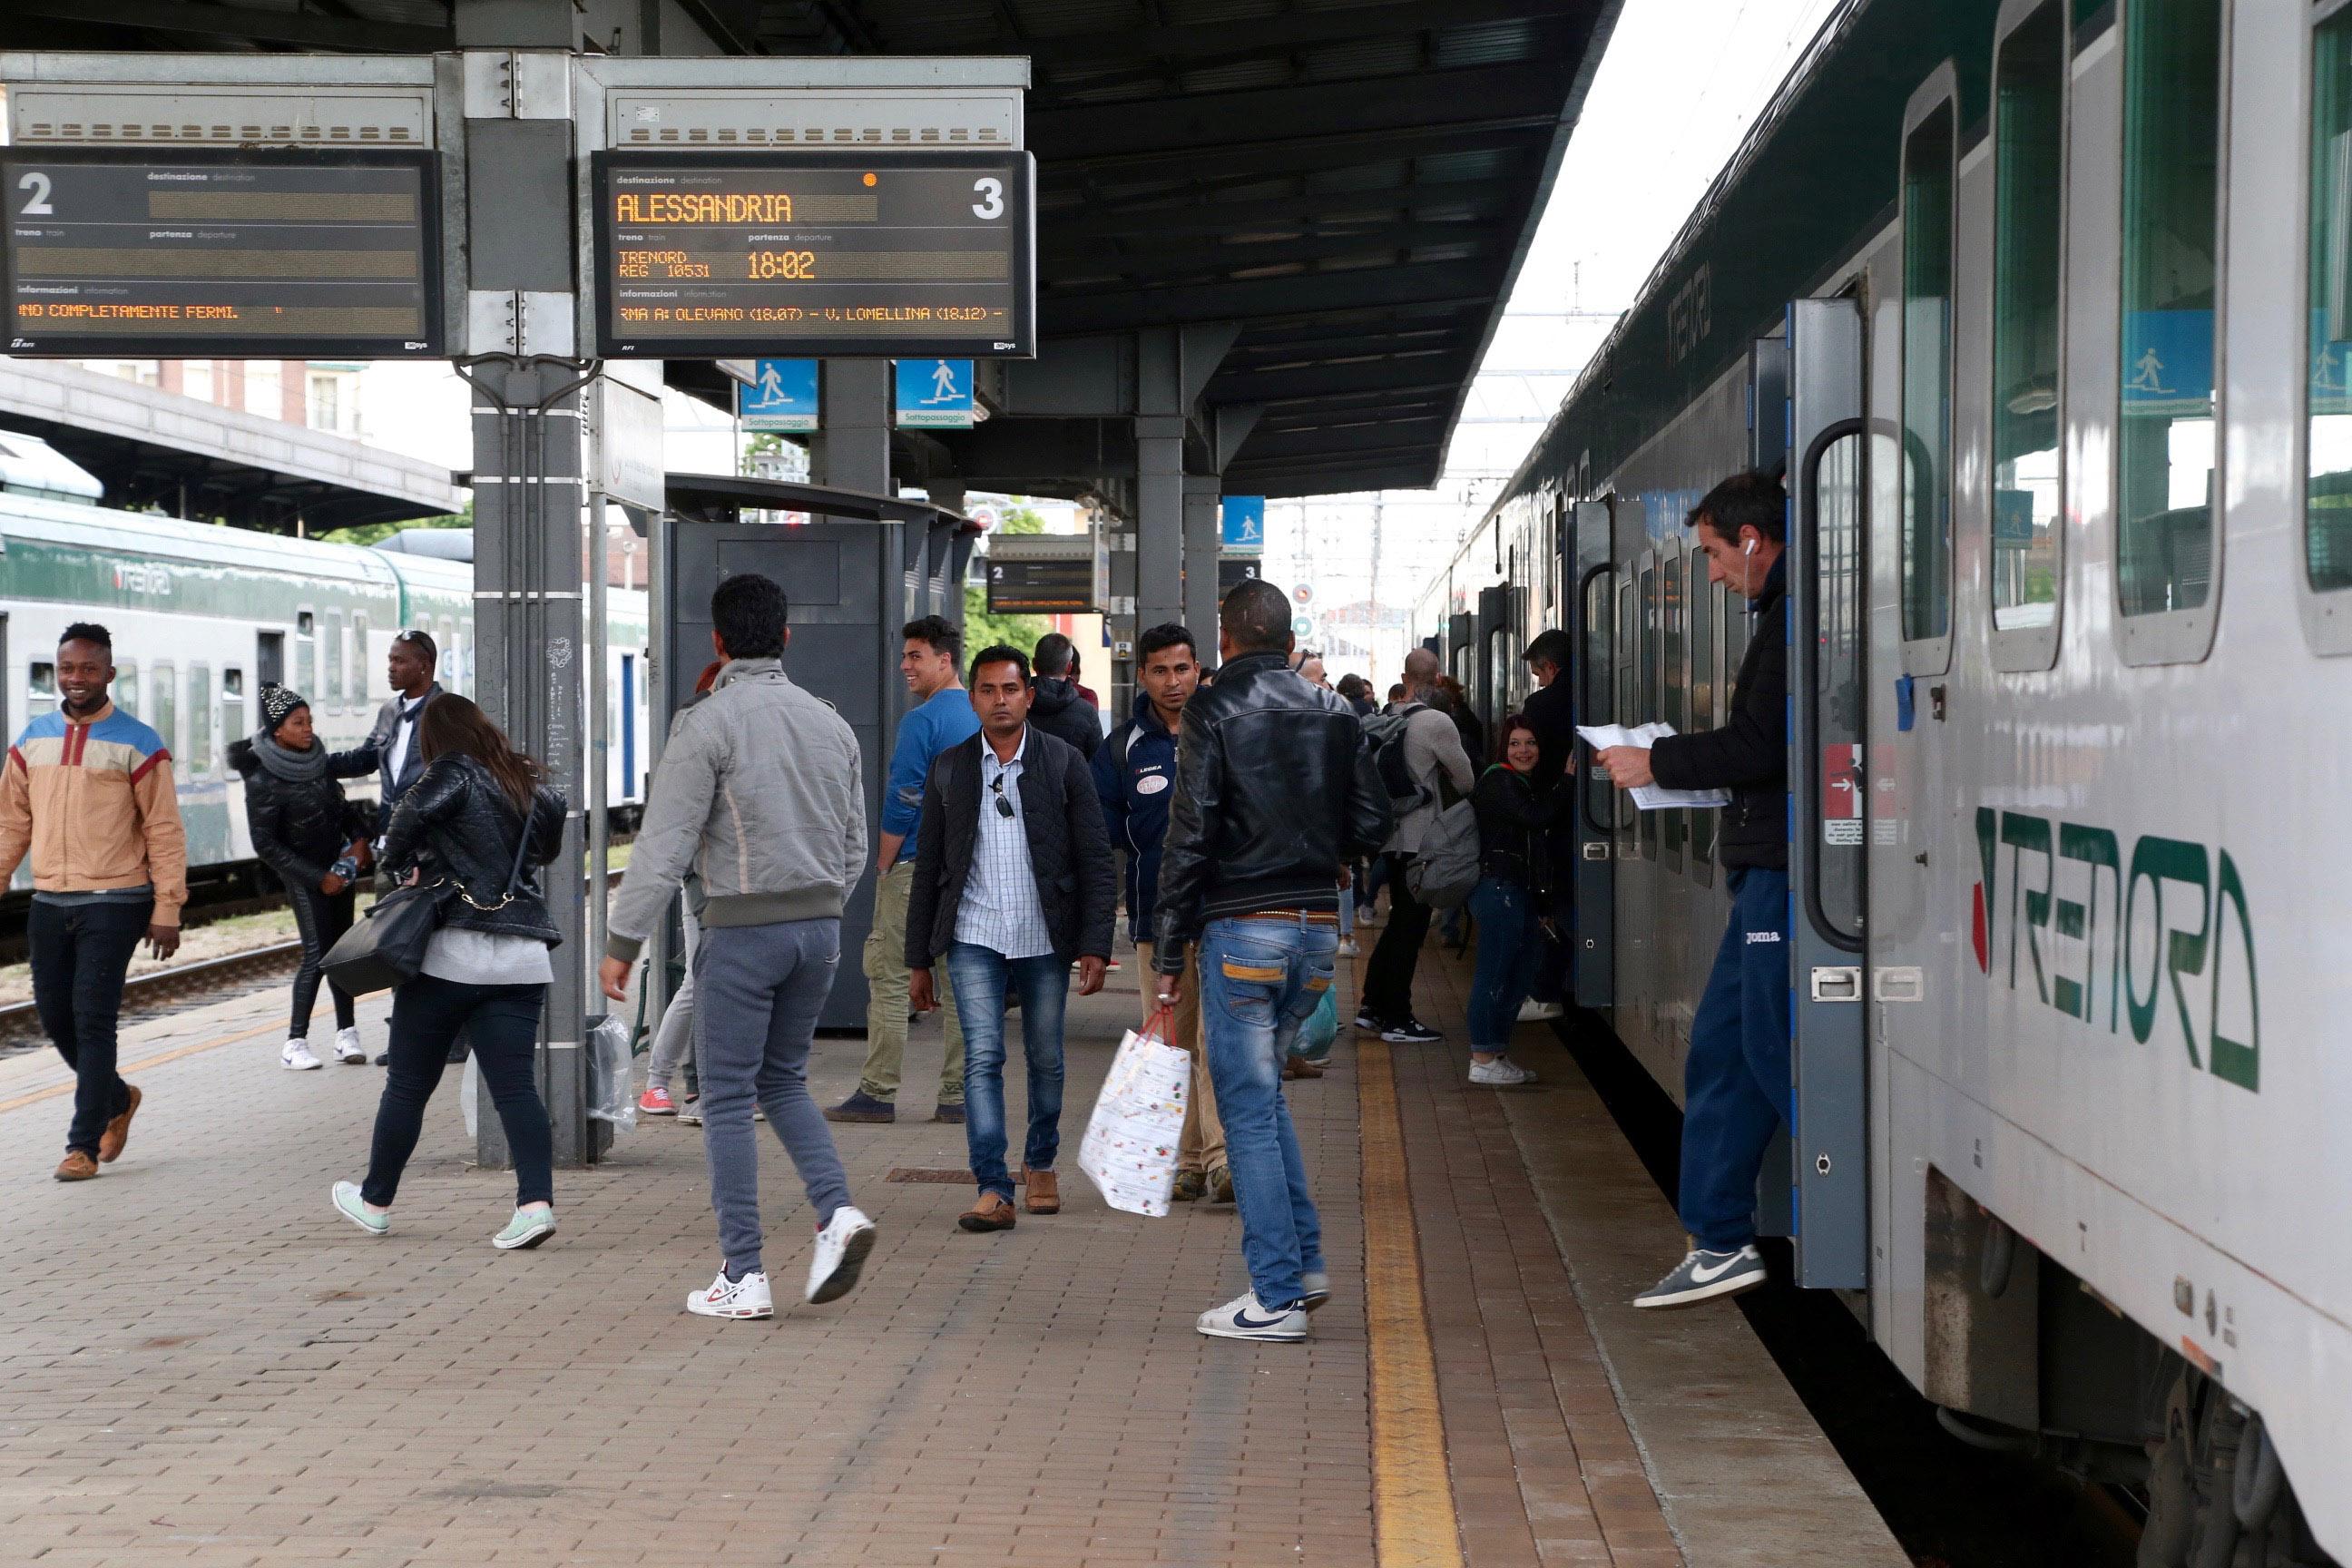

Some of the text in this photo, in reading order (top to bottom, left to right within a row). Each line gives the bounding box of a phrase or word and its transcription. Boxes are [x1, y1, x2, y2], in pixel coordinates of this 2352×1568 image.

[147, 172, 208, 181] destinazione
[617, 176, 722, 184] destinazione destination
[19, 172, 53, 215] 2
[972, 177, 1004, 220] 3
[617, 193, 791, 222] ALESSANDRIA
[150, 230, 192, 239] partenza
[618, 233, 666, 241] treno train
[749, 233, 832, 242] partenza departure
[619, 251, 687, 264] TRENORD
[619, 264, 710, 278] REG 10531
[749, 250, 815, 279] 18:02
[17, 286, 79, 294] informazioni
[620, 289, 727, 298] informazioni information
[49, 304, 180, 318] COMPLETAMENTE
[185, 306, 240, 318] FERMI.
[654, 308, 670, 320] A:
[675, 308, 743, 320] OLEVANO
[750, 308, 803, 321] (18.07)
[826, 308, 840, 320] V.
[846, 307, 930, 320] LOMELLINA
[936, 307, 987, 320] (18.12)
[749, 418, 809, 427] Sottopassaggio
[905, 413, 965, 423] Sottopassaggio
[993, 566, 1004, 579] 2
[1245, 565, 1256, 579] 3
[1975, 806, 2260, 1095] TRENORD
